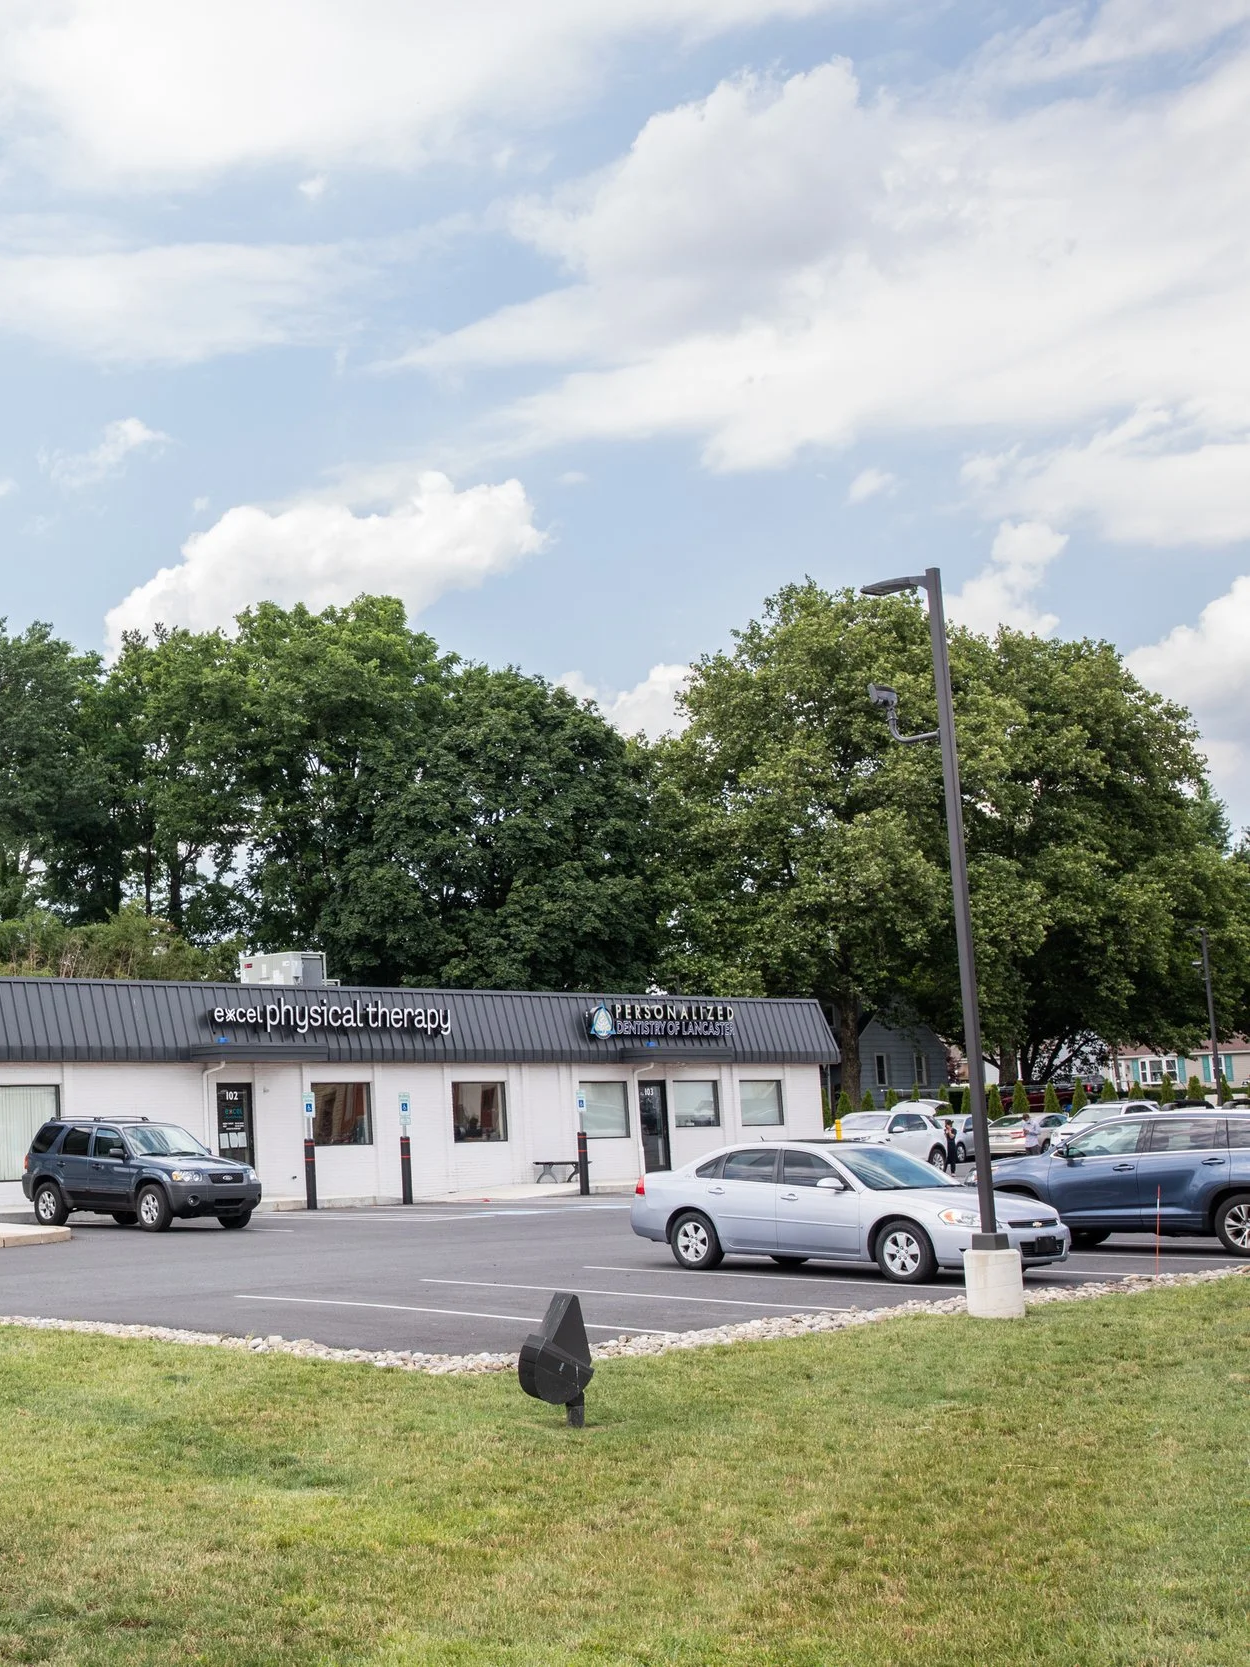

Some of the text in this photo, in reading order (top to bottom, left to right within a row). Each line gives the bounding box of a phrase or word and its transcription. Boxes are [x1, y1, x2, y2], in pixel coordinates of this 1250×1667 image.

[214, 998, 450, 1035] excel physical therapy
[615, 1004, 734, 1021] PERSONALIZED
[616, 1021, 736, 1036] DENTISTRY OF LANCASTER
[225, 1091, 239, 1100] 102
